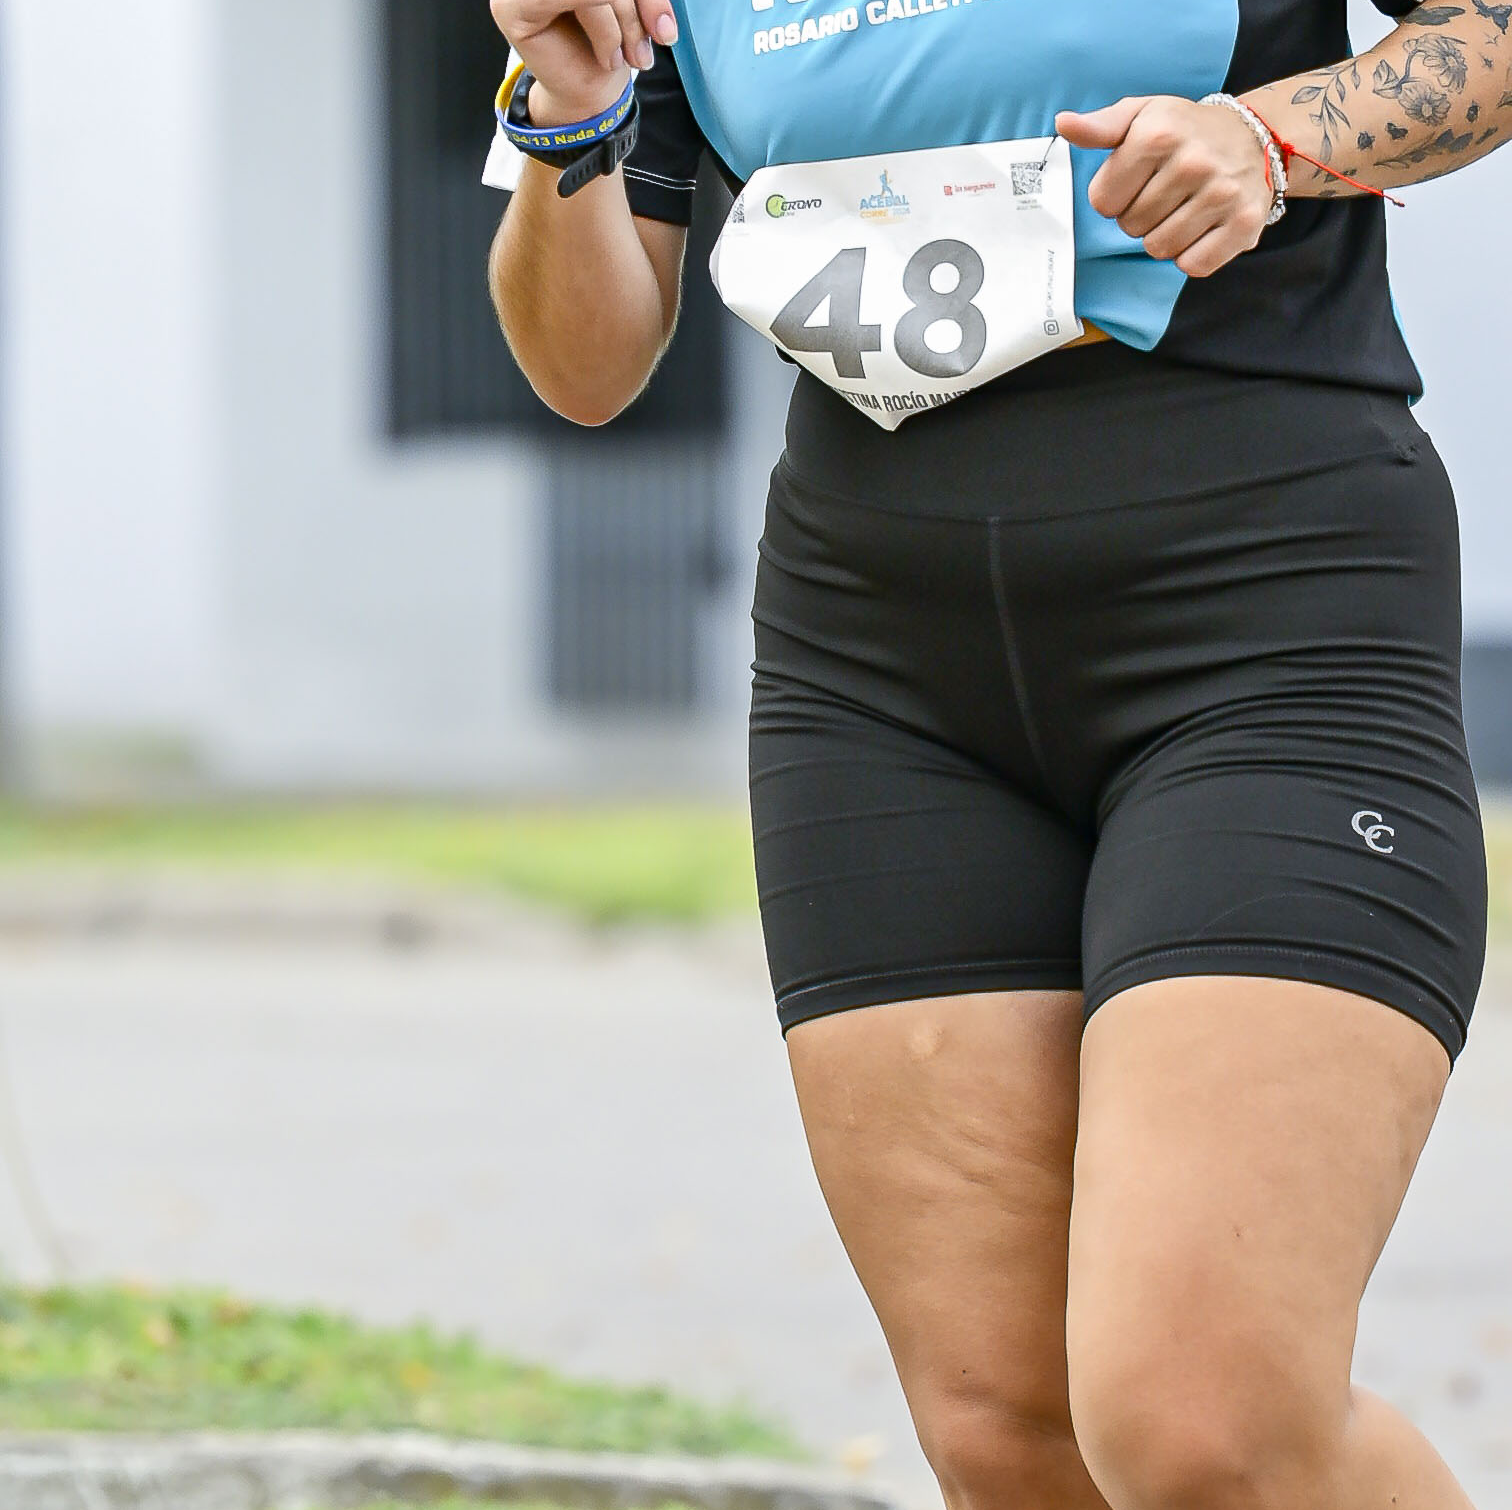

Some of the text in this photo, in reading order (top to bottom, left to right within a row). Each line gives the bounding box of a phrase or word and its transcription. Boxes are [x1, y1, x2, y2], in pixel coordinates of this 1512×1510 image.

[754, 7, 860, 56] ROSARIO
[554, 128, 596, 145] Nada
[598, 117, 615, 133] de
[769, 239, 987, 379] 48
[882, 391, 929, 411] ROCÍO
